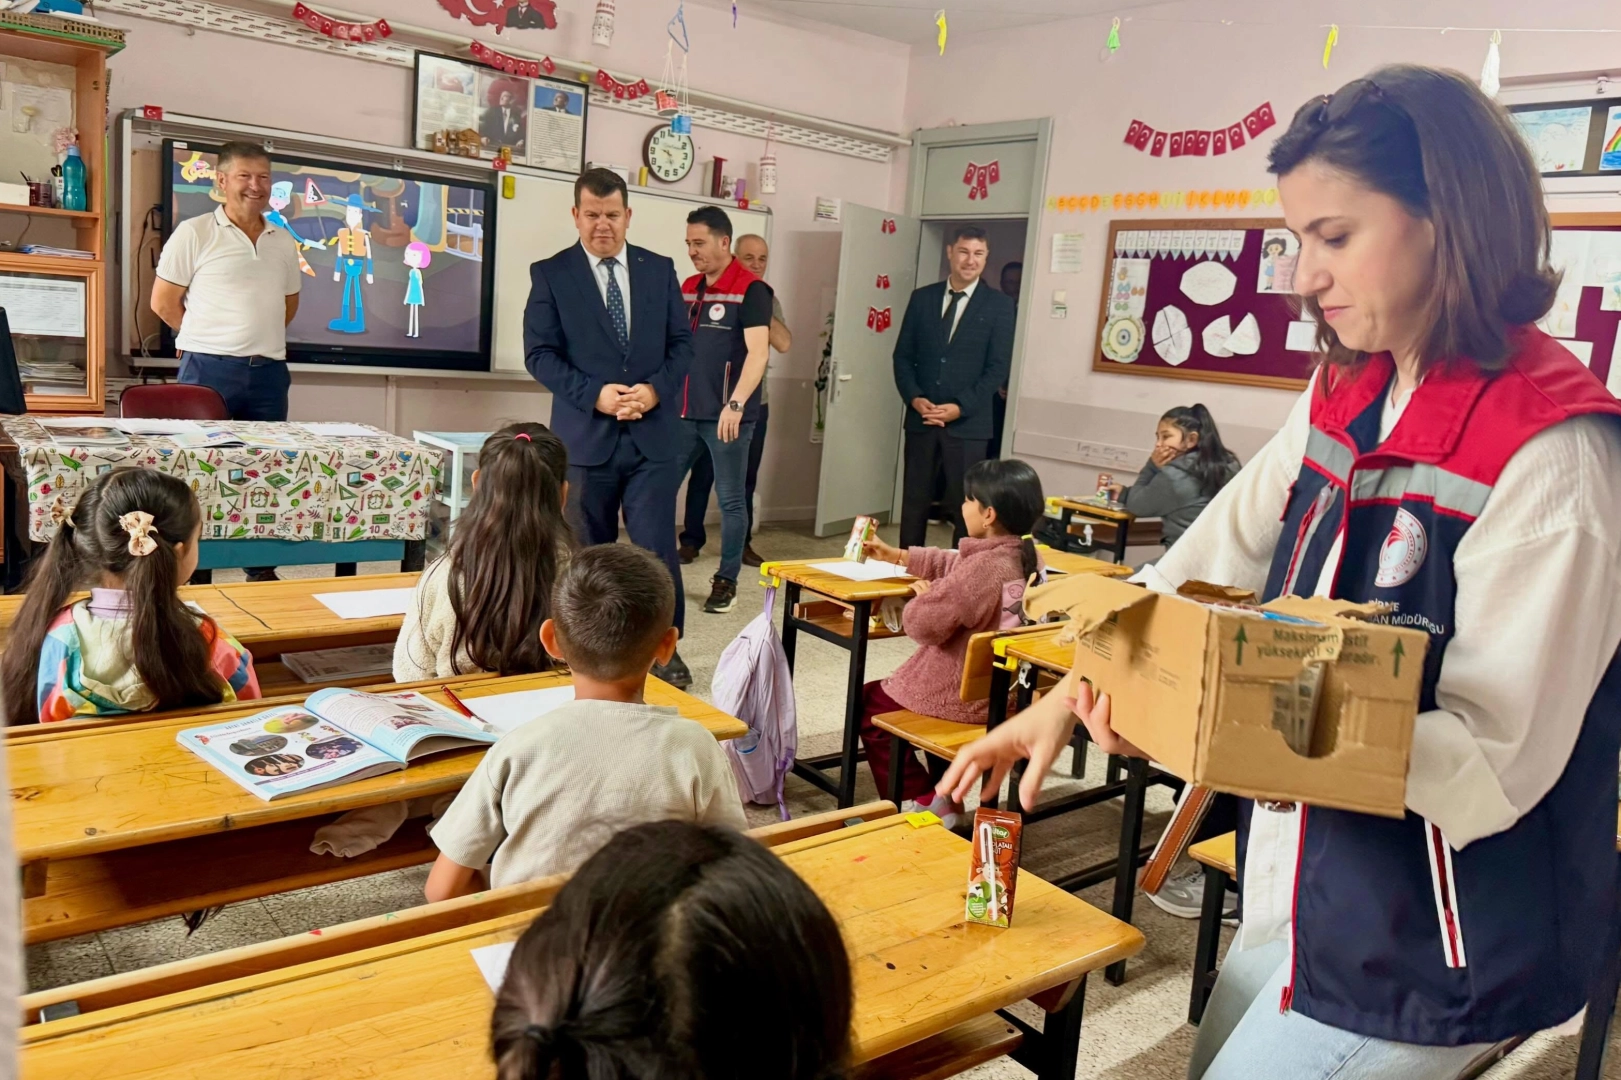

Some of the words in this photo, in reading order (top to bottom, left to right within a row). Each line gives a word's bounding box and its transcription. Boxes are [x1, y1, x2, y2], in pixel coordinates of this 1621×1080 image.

[660, 130, 665, 139] 11
[262, 463, 271, 473] 5
[379, 466, 387, 477] 5
[253, 525, 265, 534] 10
[369, 526, 380, 534] 10
